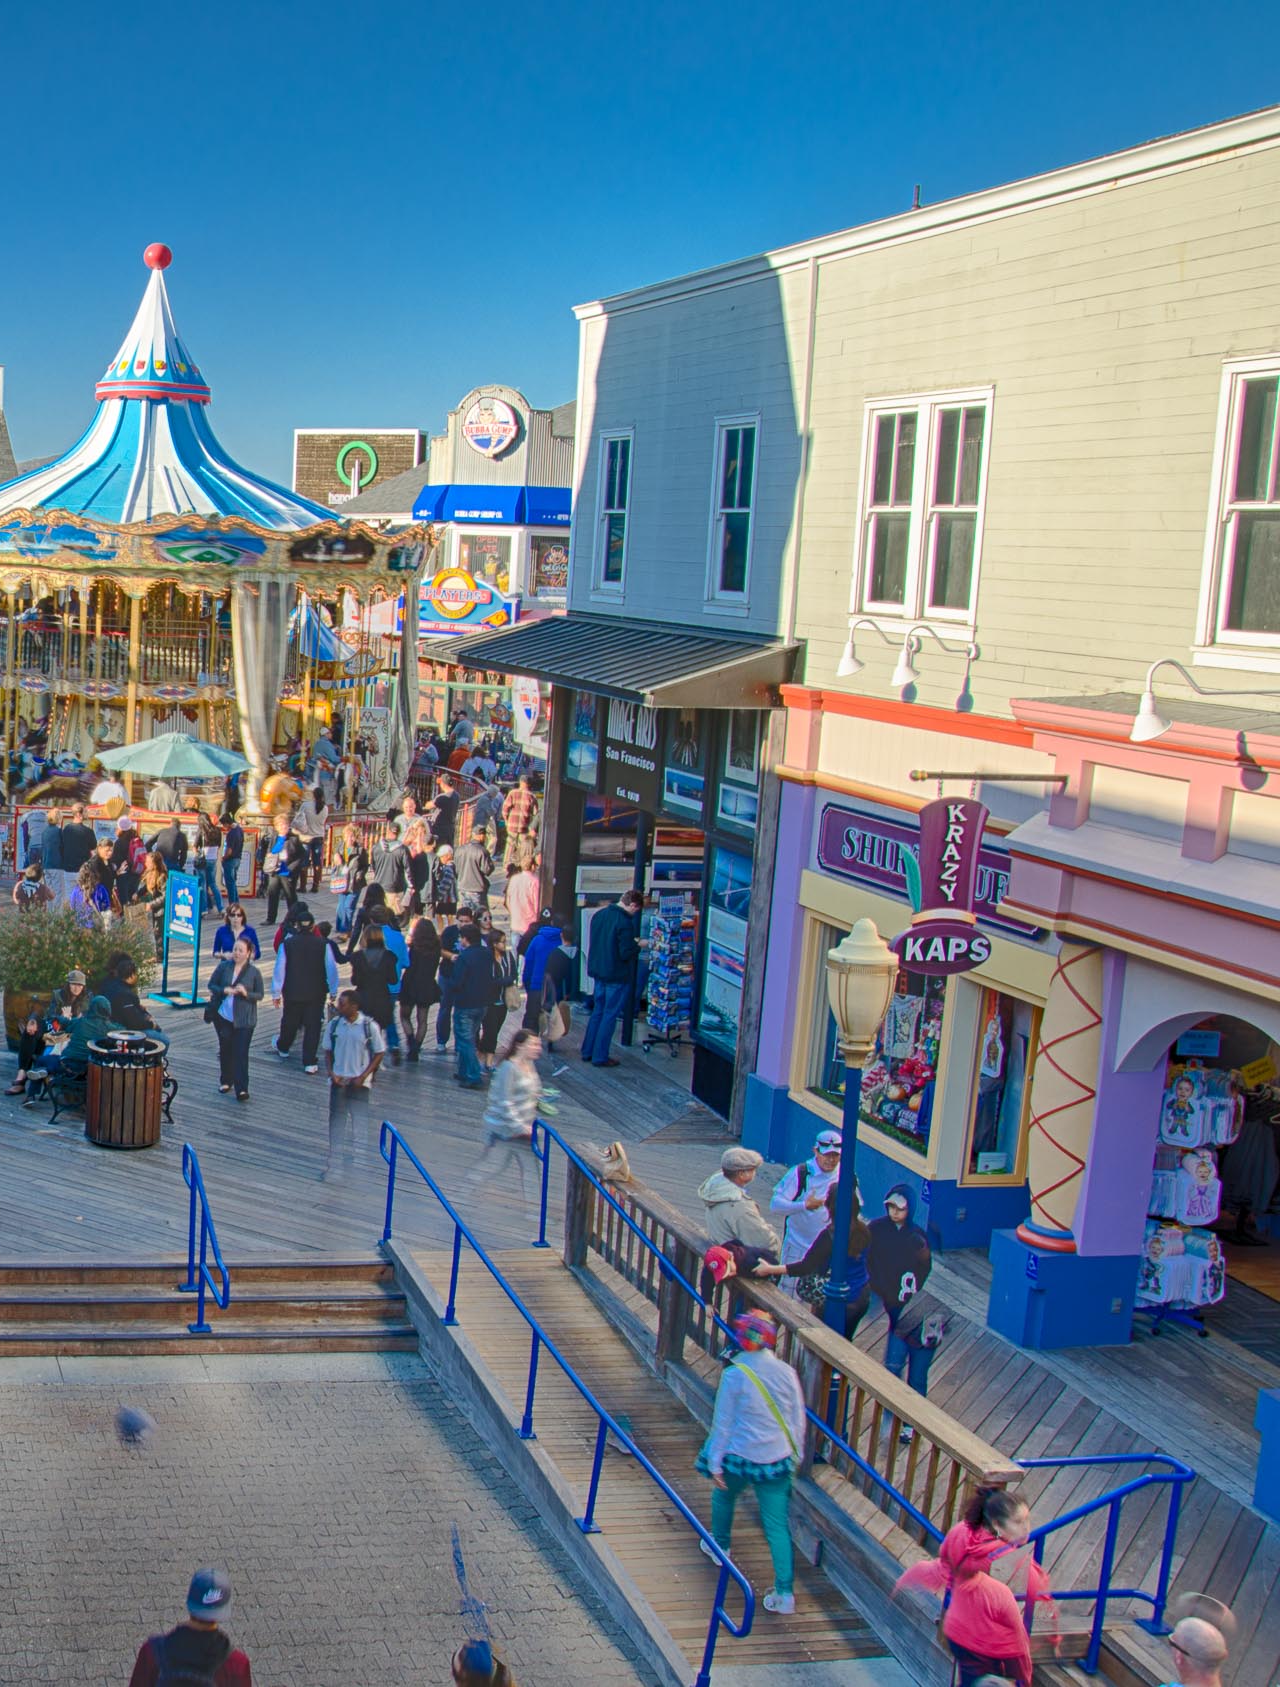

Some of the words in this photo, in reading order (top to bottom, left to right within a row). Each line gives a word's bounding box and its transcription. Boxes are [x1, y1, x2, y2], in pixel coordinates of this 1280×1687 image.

[465, 426, 490, 434] BUBBA
[492, 426, 513, 434] GUMP
[425, 588, 481, 601] PLAYERS
[606, 746, 619, 761] San
[621, 750, 655, 772] Francisco
[940, 804, 967, 902] KRAZY
[905, 937, 991, 962] KAPS
